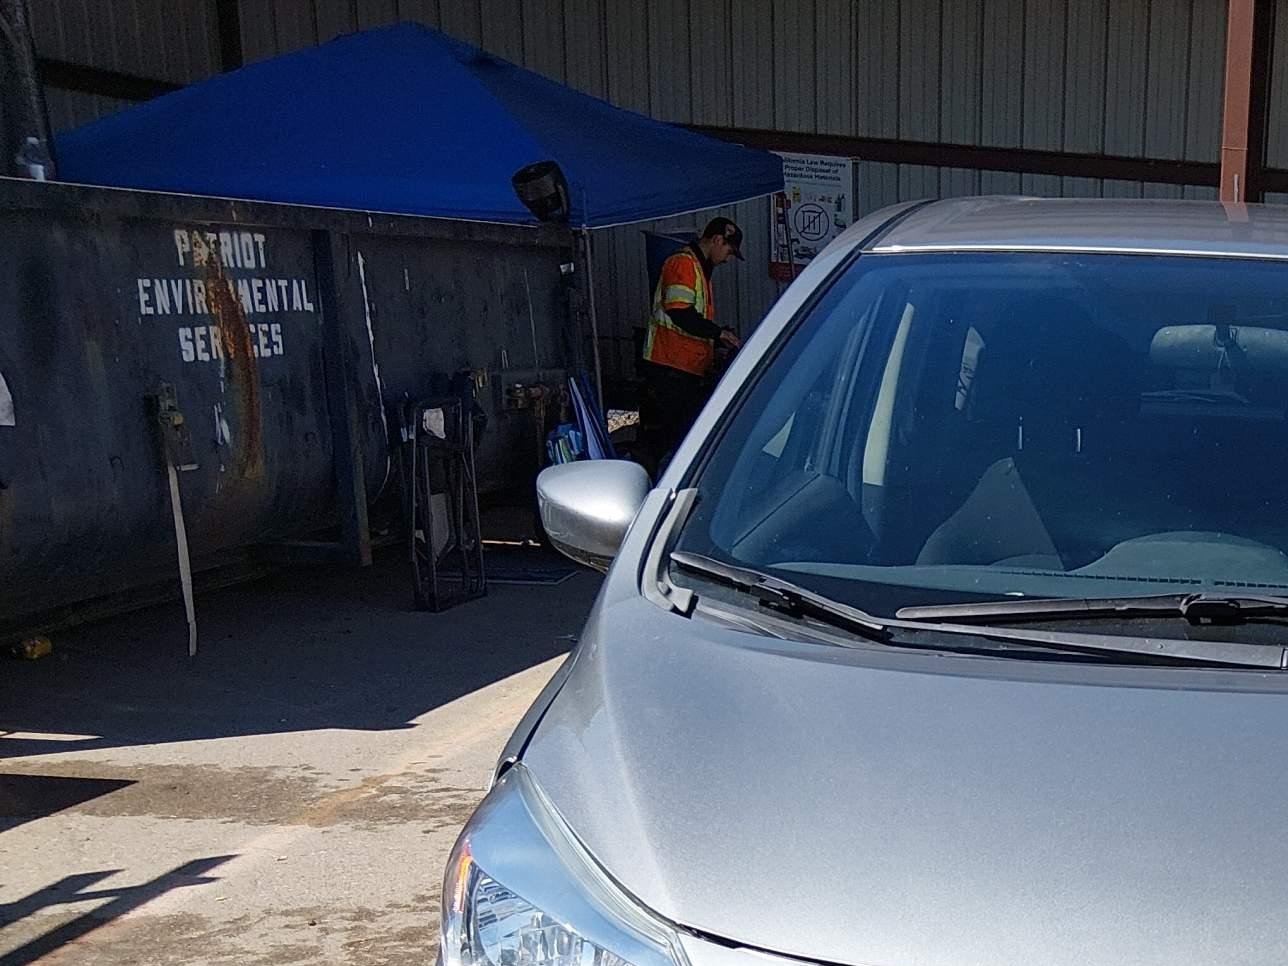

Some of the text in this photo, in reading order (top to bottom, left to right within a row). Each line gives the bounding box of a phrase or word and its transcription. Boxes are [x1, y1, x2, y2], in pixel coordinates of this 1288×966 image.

[784, 157, 806, 165] lifornia
[819, 160, 847, 168] Requires
[784, 164, 804, 172] Proper
[805, 166, 831, 174] Disposal
[814, 173, 841, 181] Materials
[174, 229, 266, 268] PATRIOT
[137, 277, 314, 315] ENVIRMENTAL
[178, 323, 283, 362] SERCES
